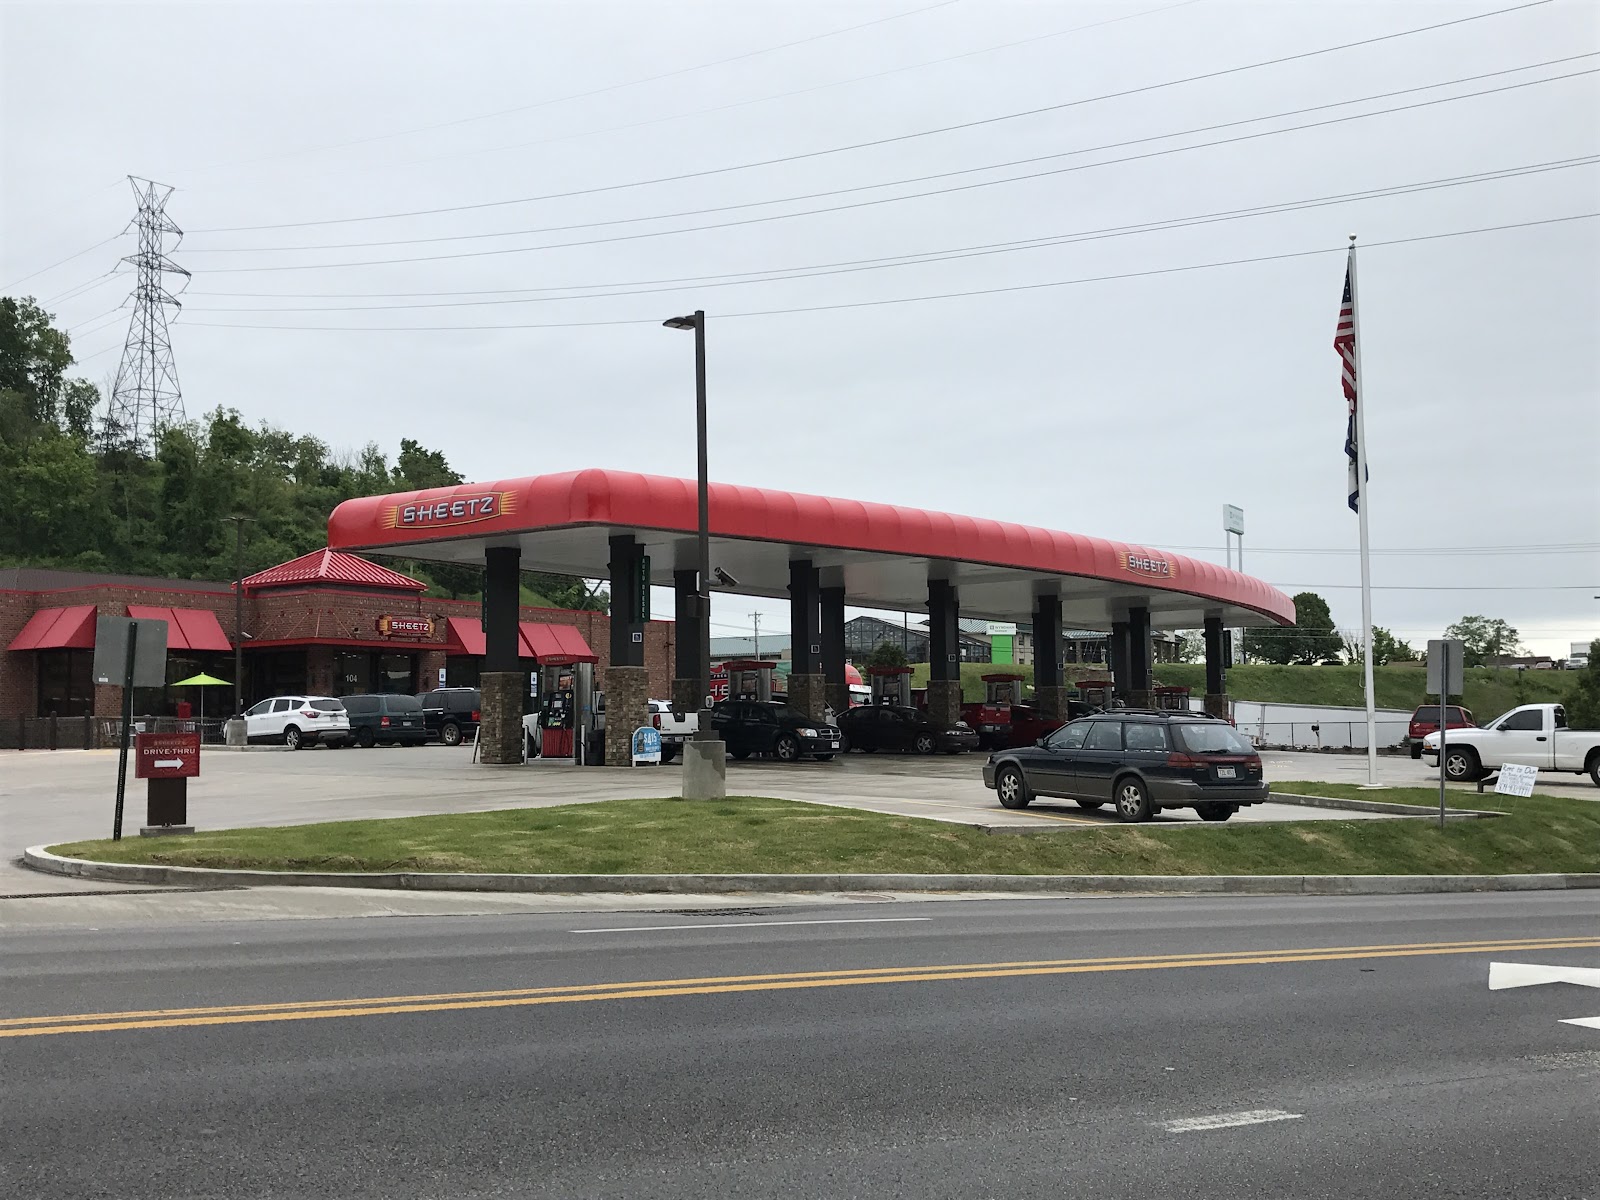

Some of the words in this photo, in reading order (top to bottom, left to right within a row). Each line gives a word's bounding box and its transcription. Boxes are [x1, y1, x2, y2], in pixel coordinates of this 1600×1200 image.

[403, 496, 494, 523] SHEETZ
[1128, 555, 1168, 574] SHEETZ
[391, 621, 429, 631] SHEETZ
[345, 674, 358, 683] 104
